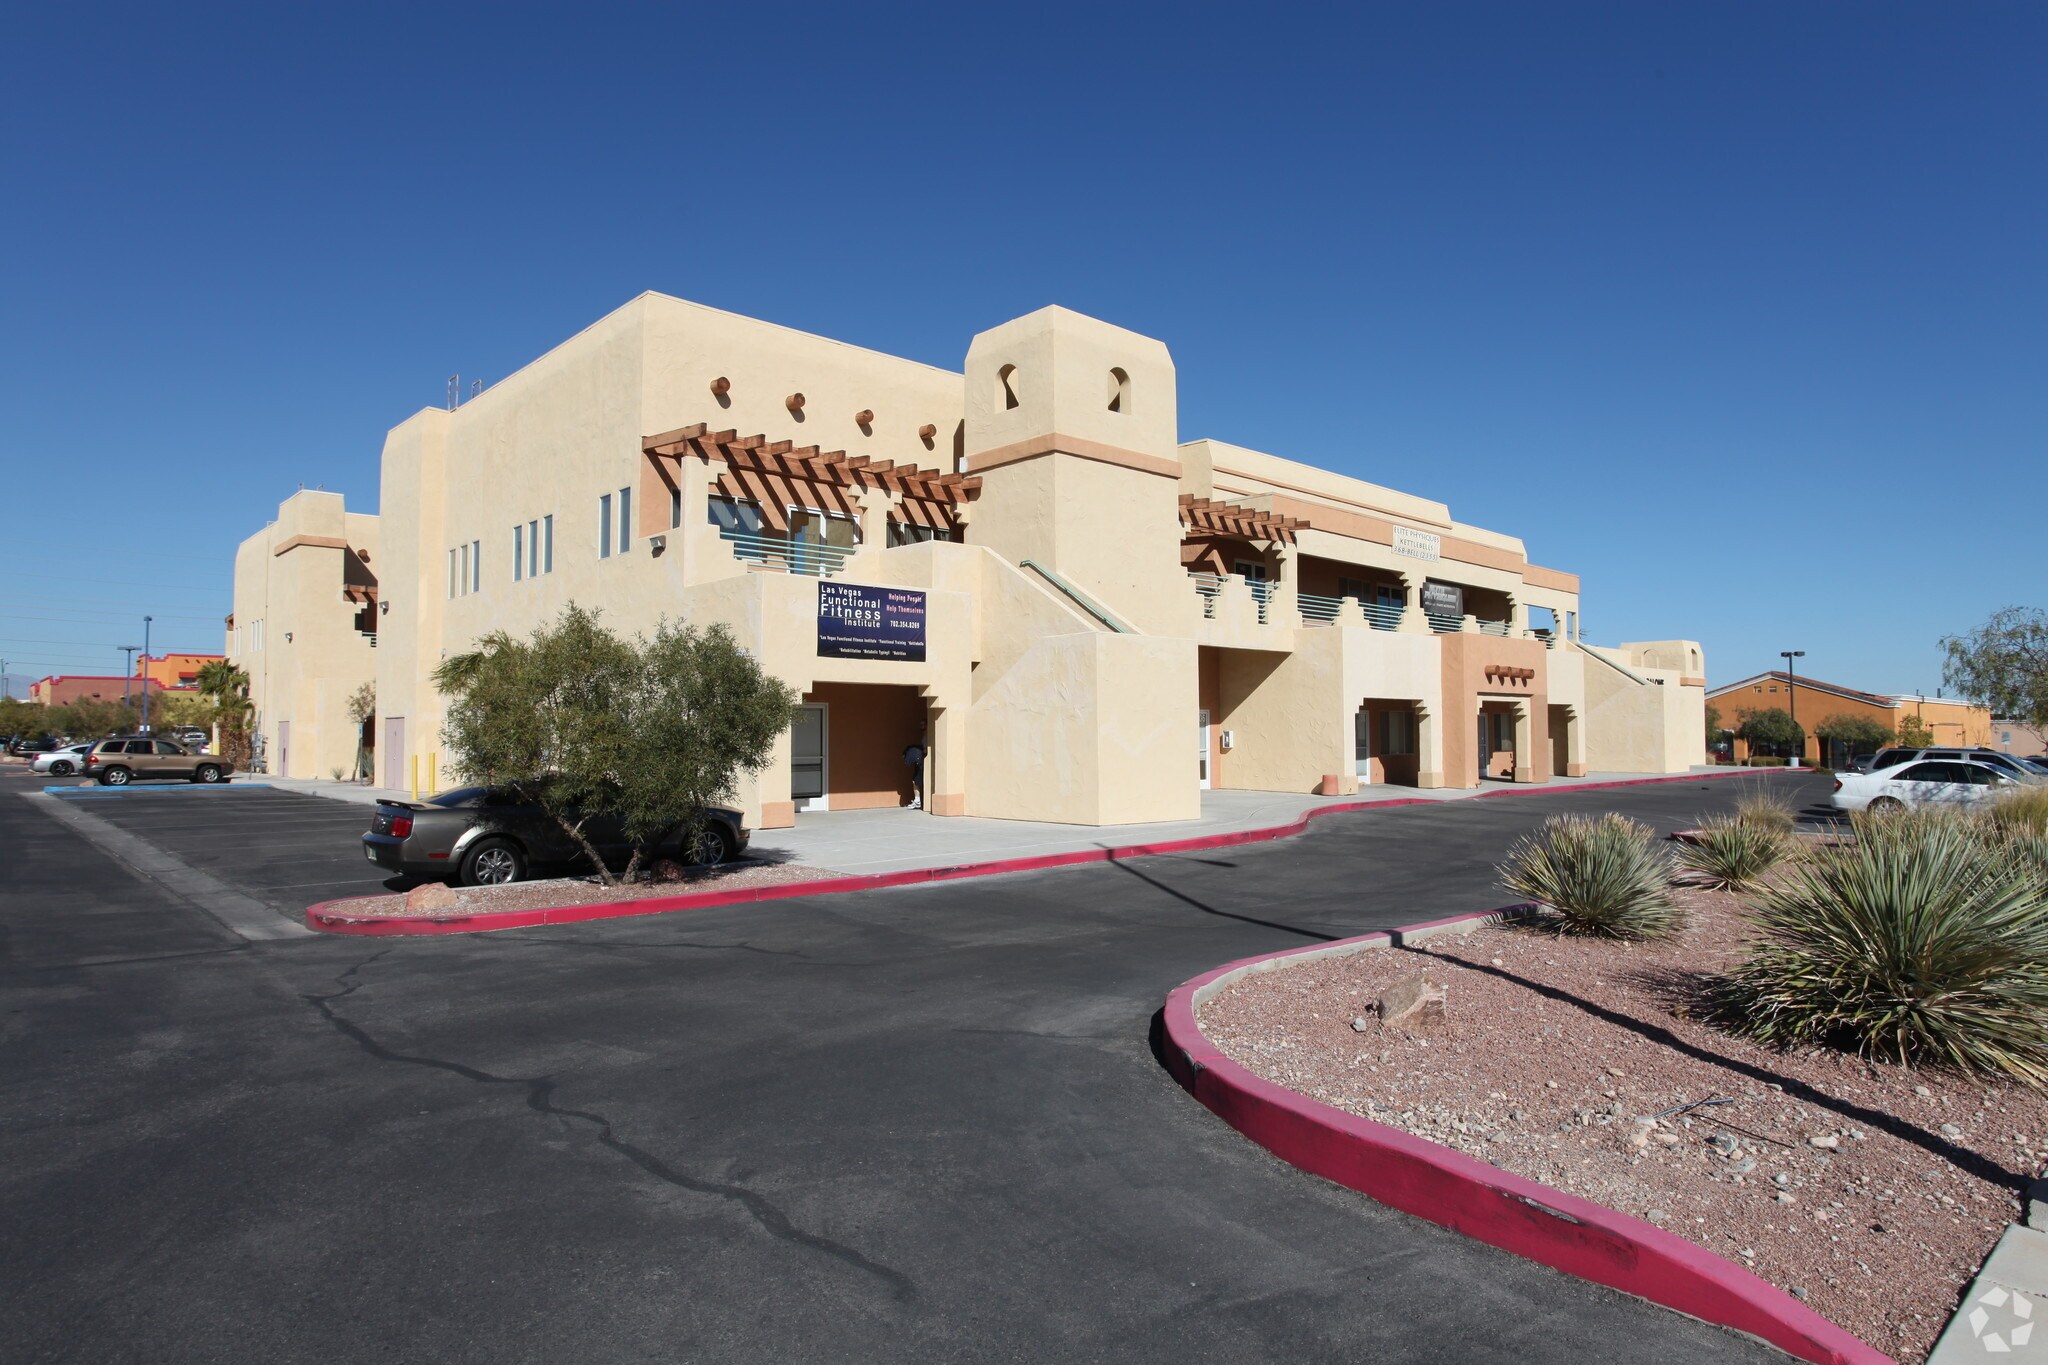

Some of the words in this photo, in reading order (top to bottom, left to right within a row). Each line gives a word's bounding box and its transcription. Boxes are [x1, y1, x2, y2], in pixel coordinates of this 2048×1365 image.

[1394, 526, 1409, 536] ELITE
[1410, 530, 1440, 543] PHYSIQUES
[1399, 537, 1433, 551] KETTLEBELLS
[821, 585, 836, 594] Las
[838, 587, 862, 597] Vegas
[821, 594, 880, 609] Functional
[888, 593, 906, 603] Helping
[820, 604, 881, 620] Fitness
[886, 604, 897, 613] Help
[898, 605, 924, 614] Themselves
[844, 618, 880, 628] Institute
